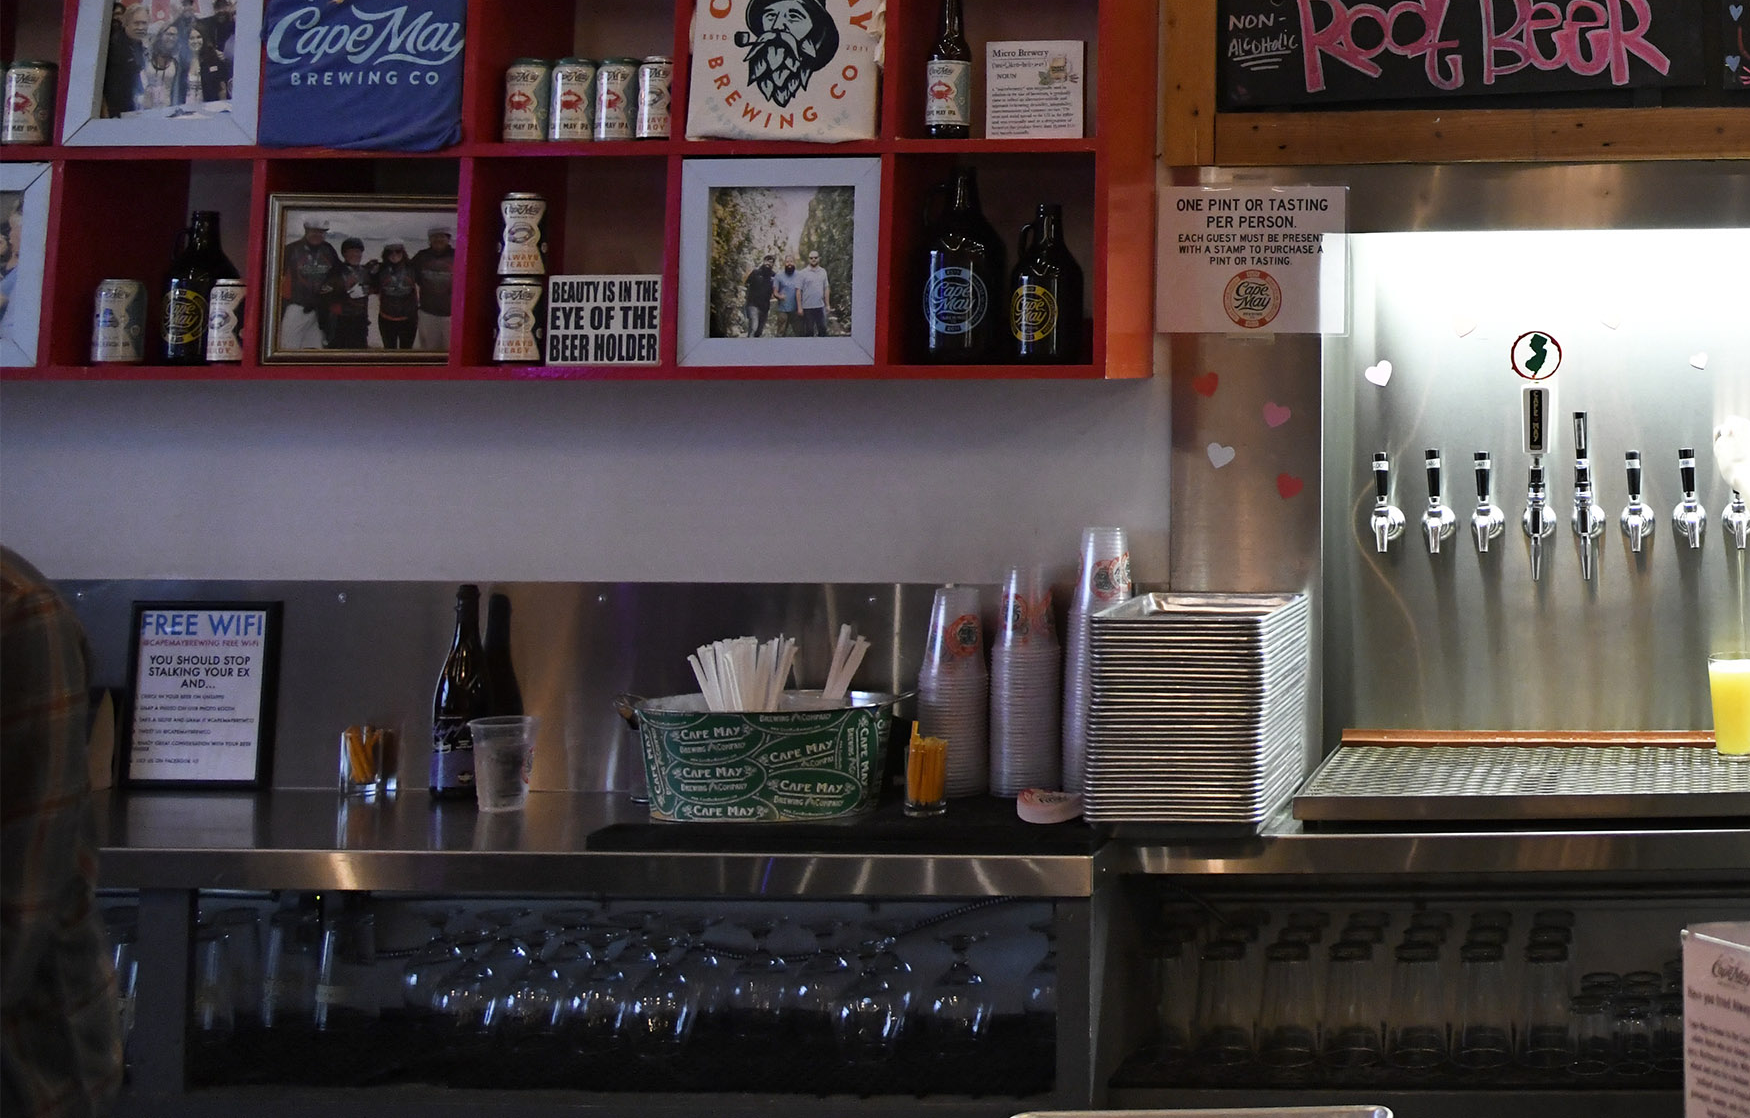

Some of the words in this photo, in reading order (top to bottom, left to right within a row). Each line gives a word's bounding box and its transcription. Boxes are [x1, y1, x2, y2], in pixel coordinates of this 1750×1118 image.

[266, 6, 374, 64] Cape
[347, 5, 465, 66] May
[1018, 49, 1049, 57] Brewery
[291, 71, 398, 85] BREWING
[410, 72, 439, 85] CO
[1177, 199, 1203, 211] ONE
[1208, 199, 1240, 211] PINT
[1245, 199, 1263, 211] OR
[1269, 199, 1328, 211] TASTING
[1207, 216, 1233, 228] PER
[1239, 216, 1297, 228] PERSON.
[1178, 234, 1203, 242] EACH
[1207, 234, 1237, 242] GUEST
[1240, 234, 1264, 242] MUST
[1268, 234, 1279, 242] BE
[1283, 234, 1324, 242] PRESENT
[1179, 245, 1201, 254] WITH
[1205, 246, 1211, 254] A
[1215, 245, 1246, 254] STAMP
[1250, 245, 1260, 254] TO
[1264, 245, 1313, 254] PURCHASE
[1317, 245, 1324, 254] A
[1210, 257, 1231, 265] PINT
[1235, 257, 1247, 265] OR
[1252, 257, 1292, 265] TASTING.
[552, 281, 599, 303] BEAUTY
[603, 281, 615, 303] IS
[619, 281, 631, 302] IN
[635, 280, 658, 302] THE
[551, 307, 584, 330] EYE
[590, 307, 615, 330] OF
[620, 306, 658, 329] THE
[550, 334, 589, 362] BEER
[594, 334, 657, 361] HOLDER
[141, 614, 199, 636] FREE
[208, 614, 263, 636] WIFI
[150, 656, 173, 665] YOU
[177, 656, 220, 665] SHOULD
[224, 656, 251, 665] STOP
[149, 667, 200, 677] STALKING
[205, 668, 234, 677] YOUR
[237, 668, 250, 677] EX
